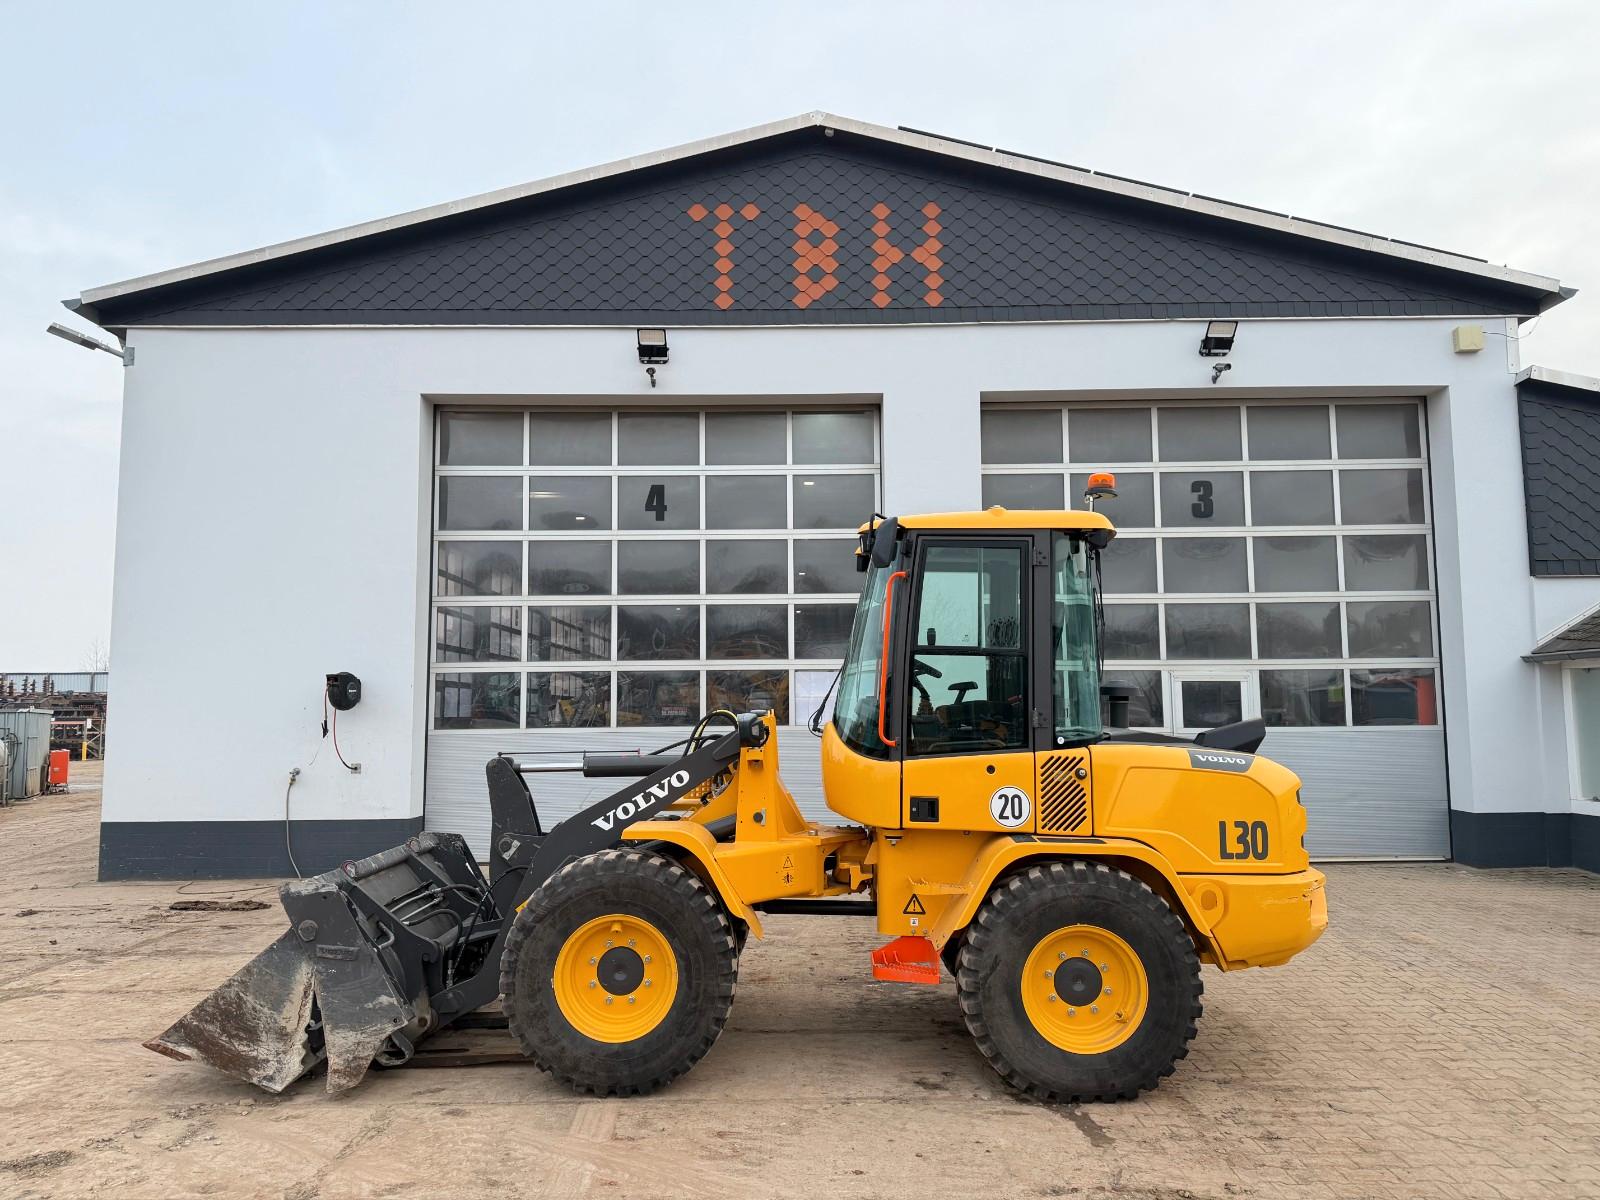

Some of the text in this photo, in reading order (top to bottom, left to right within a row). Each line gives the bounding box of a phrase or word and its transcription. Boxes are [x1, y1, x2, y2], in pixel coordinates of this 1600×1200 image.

[688, 204, 943, 308] TBH
[645, 485, 667, 521] 4
[1191, 481, 1213, 518] 3
[1195, 754, 1246, 765] VOLVO
[591, 769, 690, 831] VOLVO
[998, 794, 1023, 820] 20
[1219, 821, 1268, 860] L30
